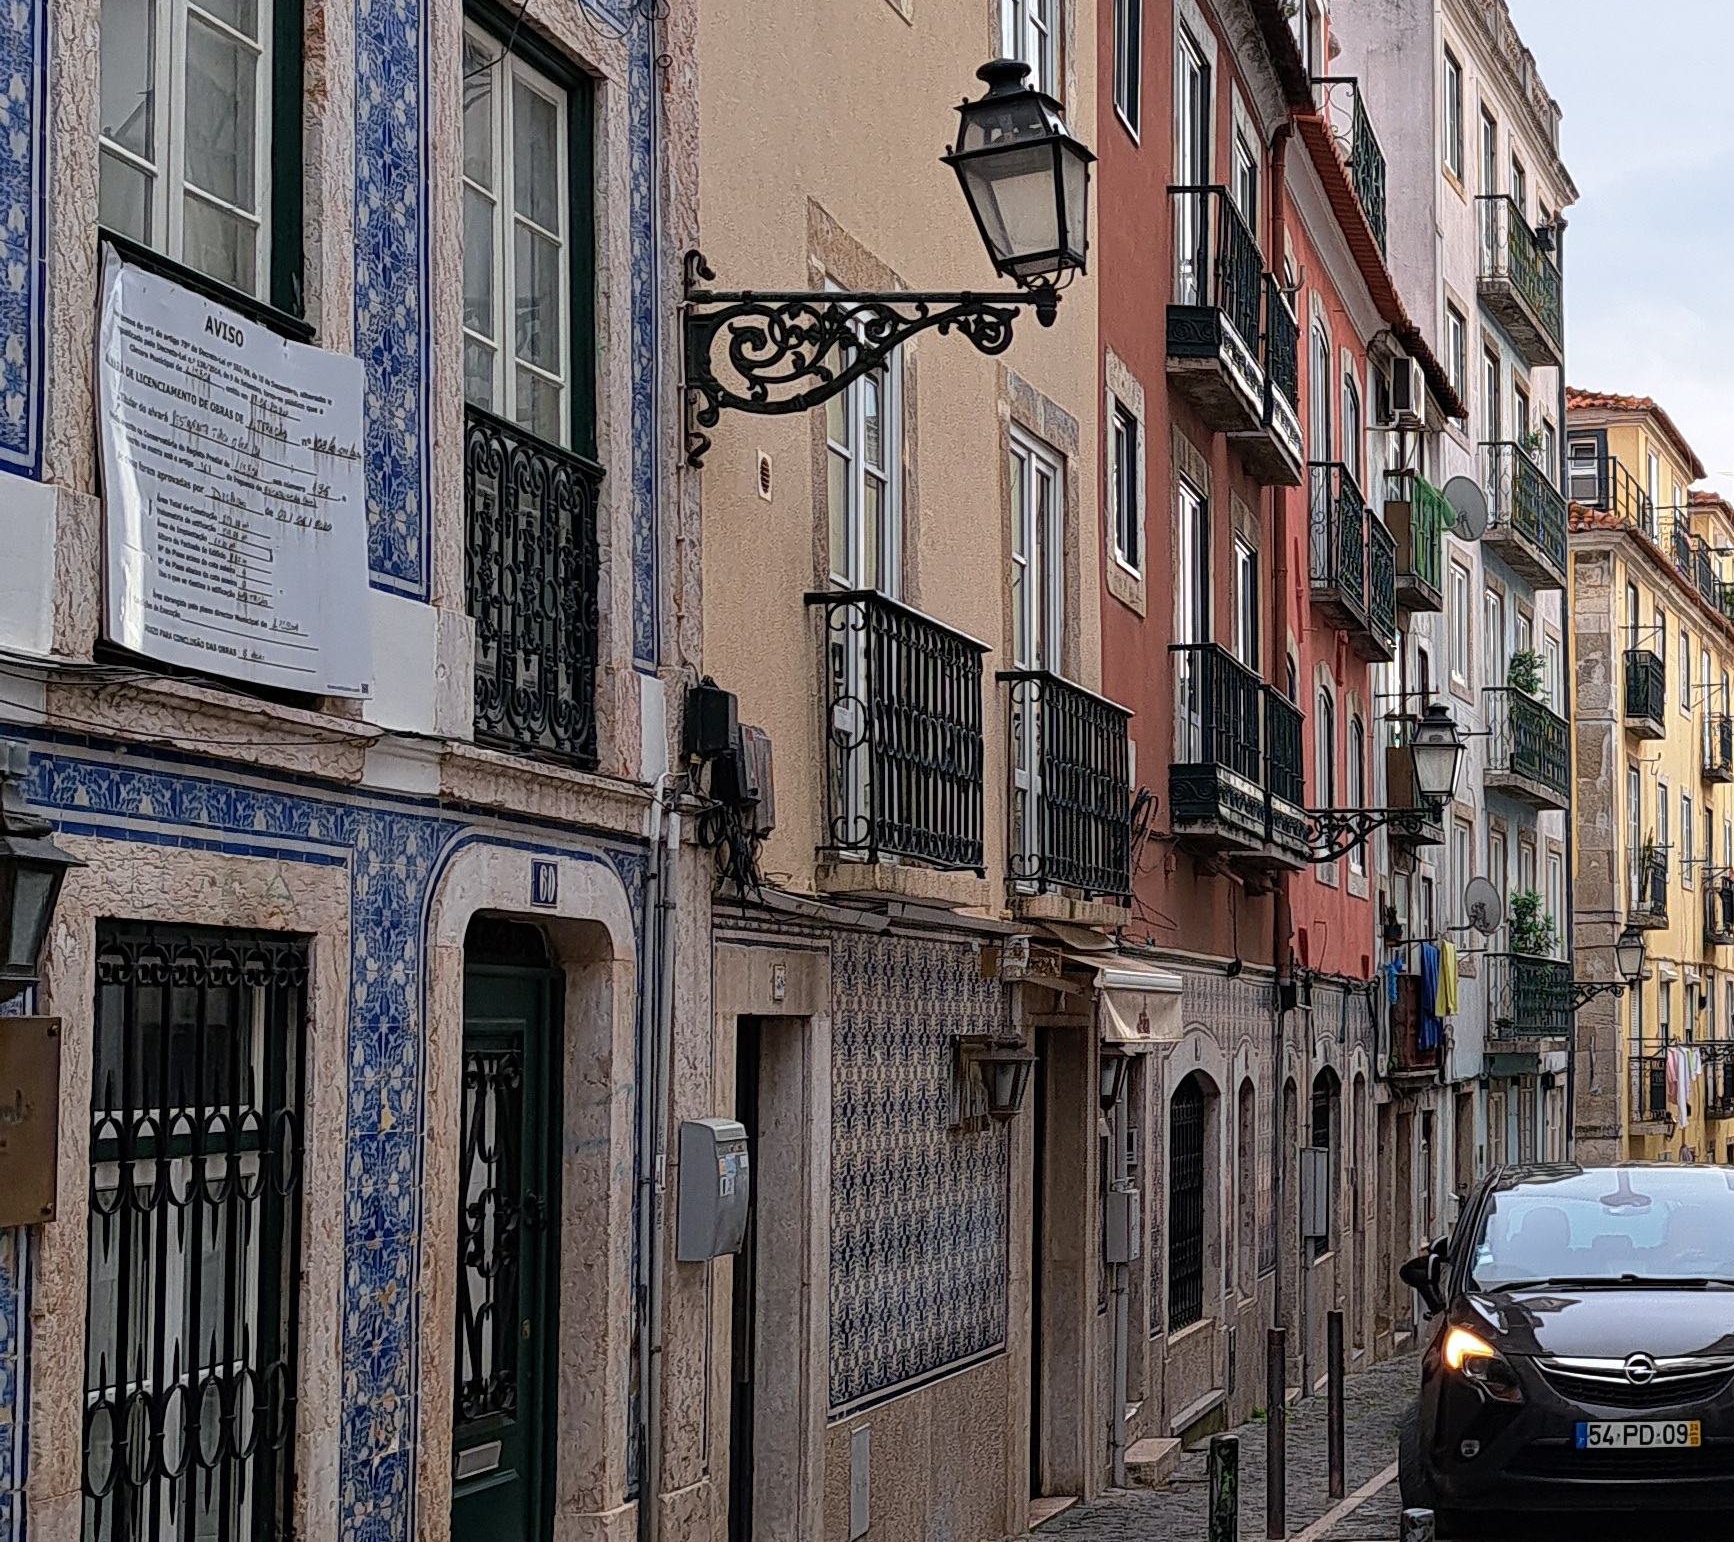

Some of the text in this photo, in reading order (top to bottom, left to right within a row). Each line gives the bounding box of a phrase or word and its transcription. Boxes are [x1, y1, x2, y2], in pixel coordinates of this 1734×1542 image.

[205, 315, 244, 348] AVISO
[135, 370, 196, 406] LICENCIAMENTO
[540, 864, 556, 902] 60
[1589, 1424, 1614, 1446] 54
[1624, 1424, 1655, 1446] PD
[1663, 1423, 1688, 1445] 09
